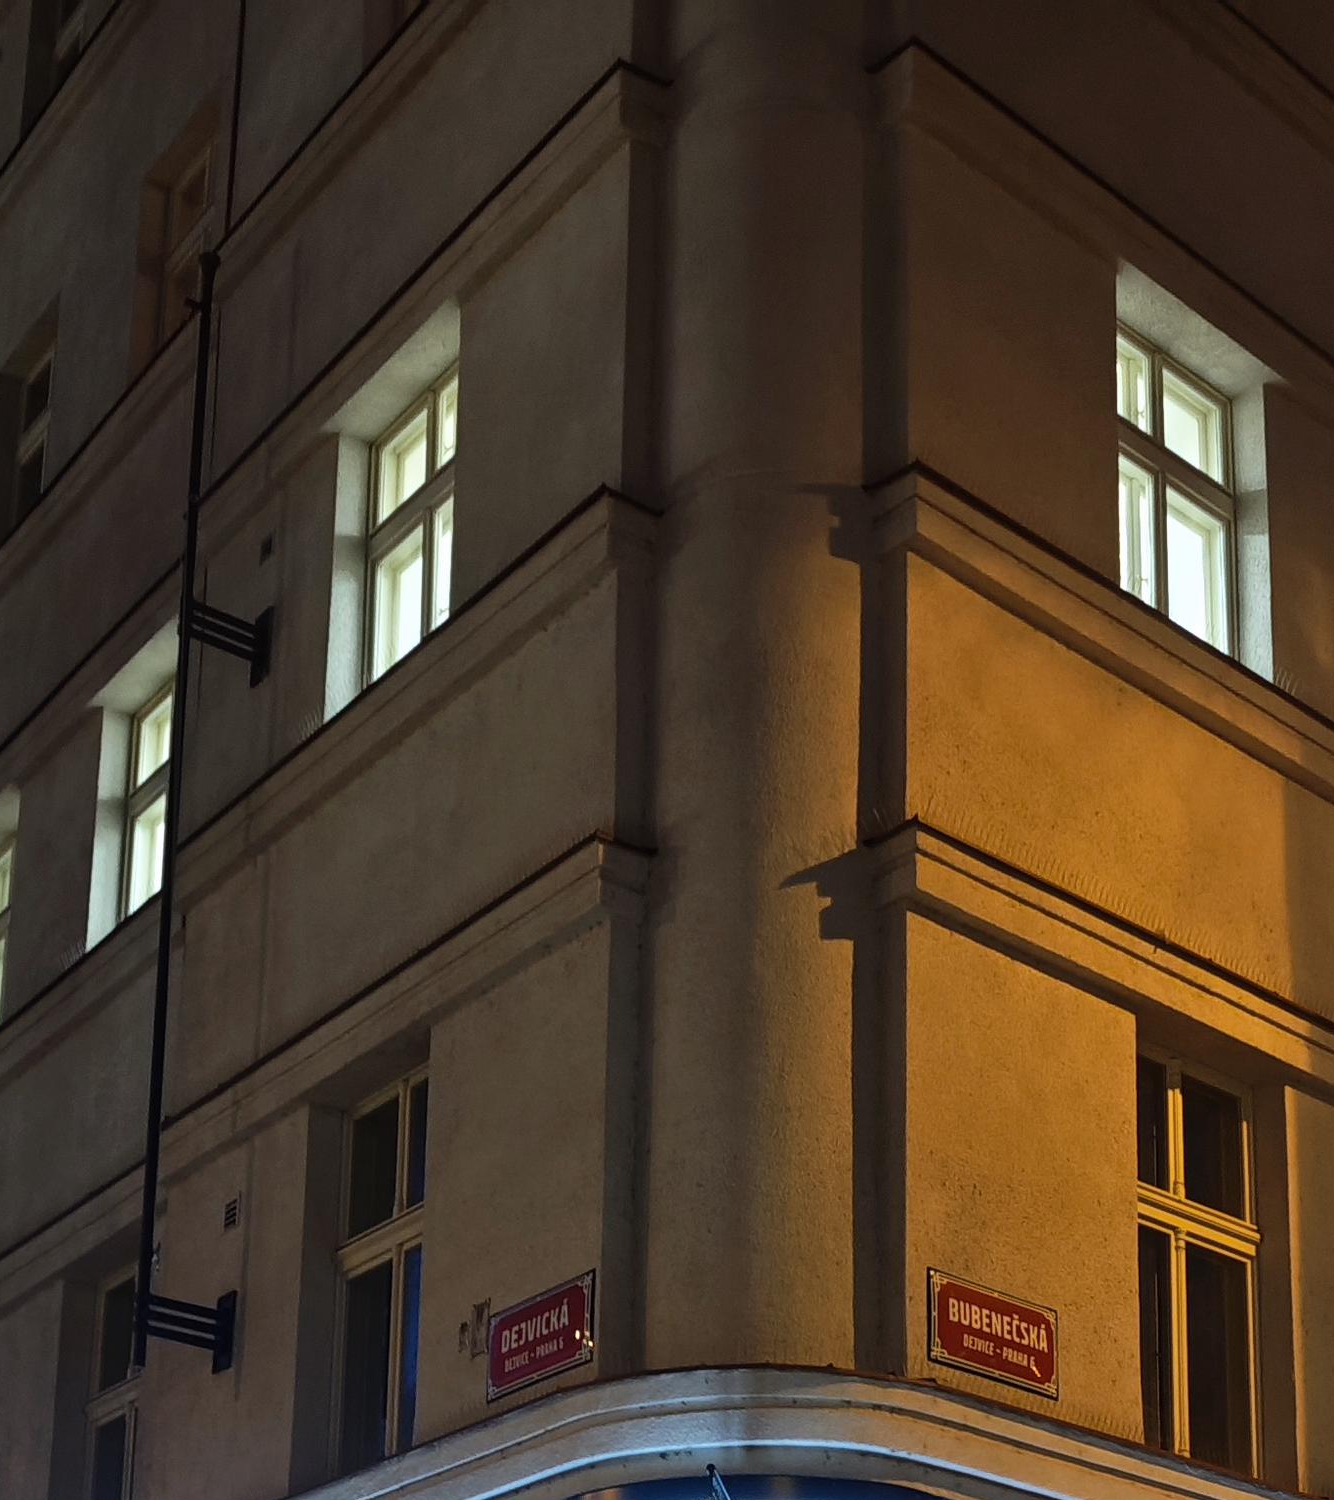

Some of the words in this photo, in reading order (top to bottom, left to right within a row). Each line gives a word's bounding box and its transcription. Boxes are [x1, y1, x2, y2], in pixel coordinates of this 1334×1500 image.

[501, 1298, 569, 1353] DEJVICKÁ
[948, 1297, 1048, 1353] BUBENEČSKÁ
[963, 1333, 995, 1356] DEJVICE
[1002, 1346, 1028, 1367] PRAHA
